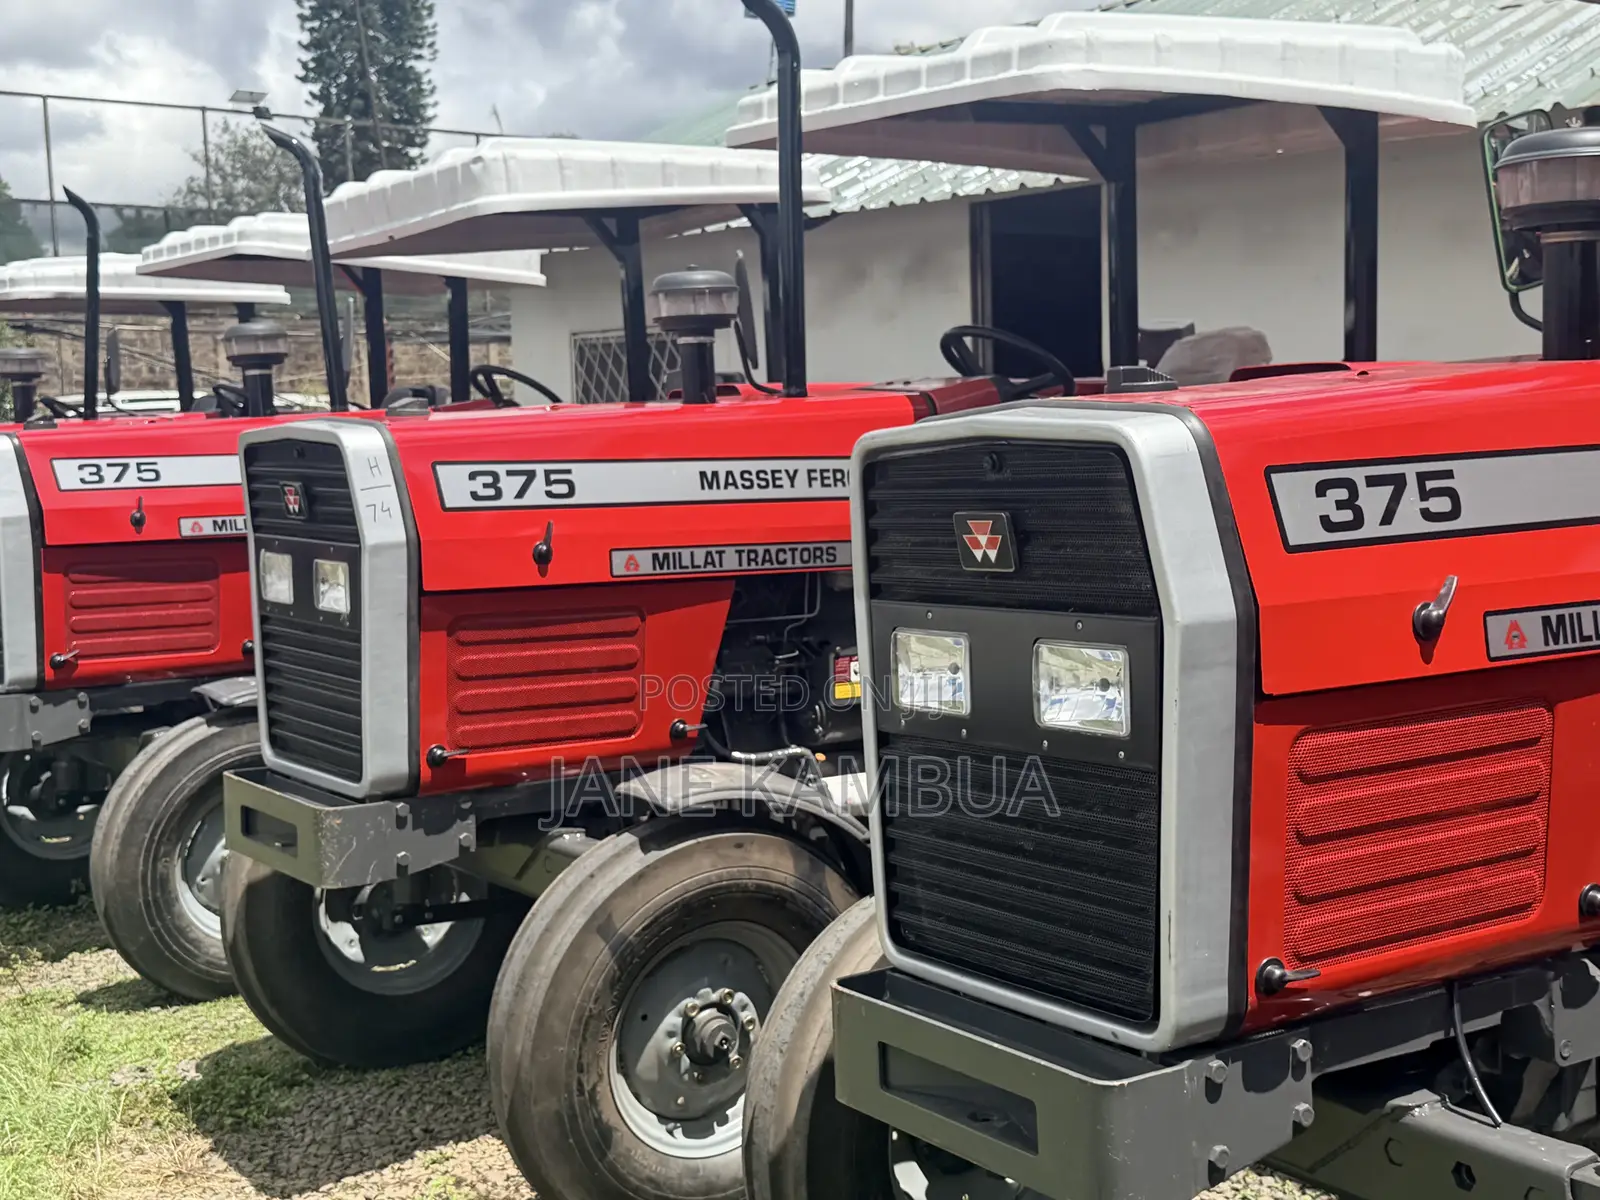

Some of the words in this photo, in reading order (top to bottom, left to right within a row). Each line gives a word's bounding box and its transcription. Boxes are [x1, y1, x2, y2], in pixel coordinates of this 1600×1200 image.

[78, 461, 161, 484] 375
[367, 456, 382, 477] H
[467, 468, 577, 502] 375
[699, 468, 799, 491] MASSEY
[806, 468, 850, 489] FER
[365, 500, 392, 523] 74
[1314, 469, 1462, 533] 375
[651, 549, 726, 571] MILLAT
[735, 546, 837, 567] TRACTORS
